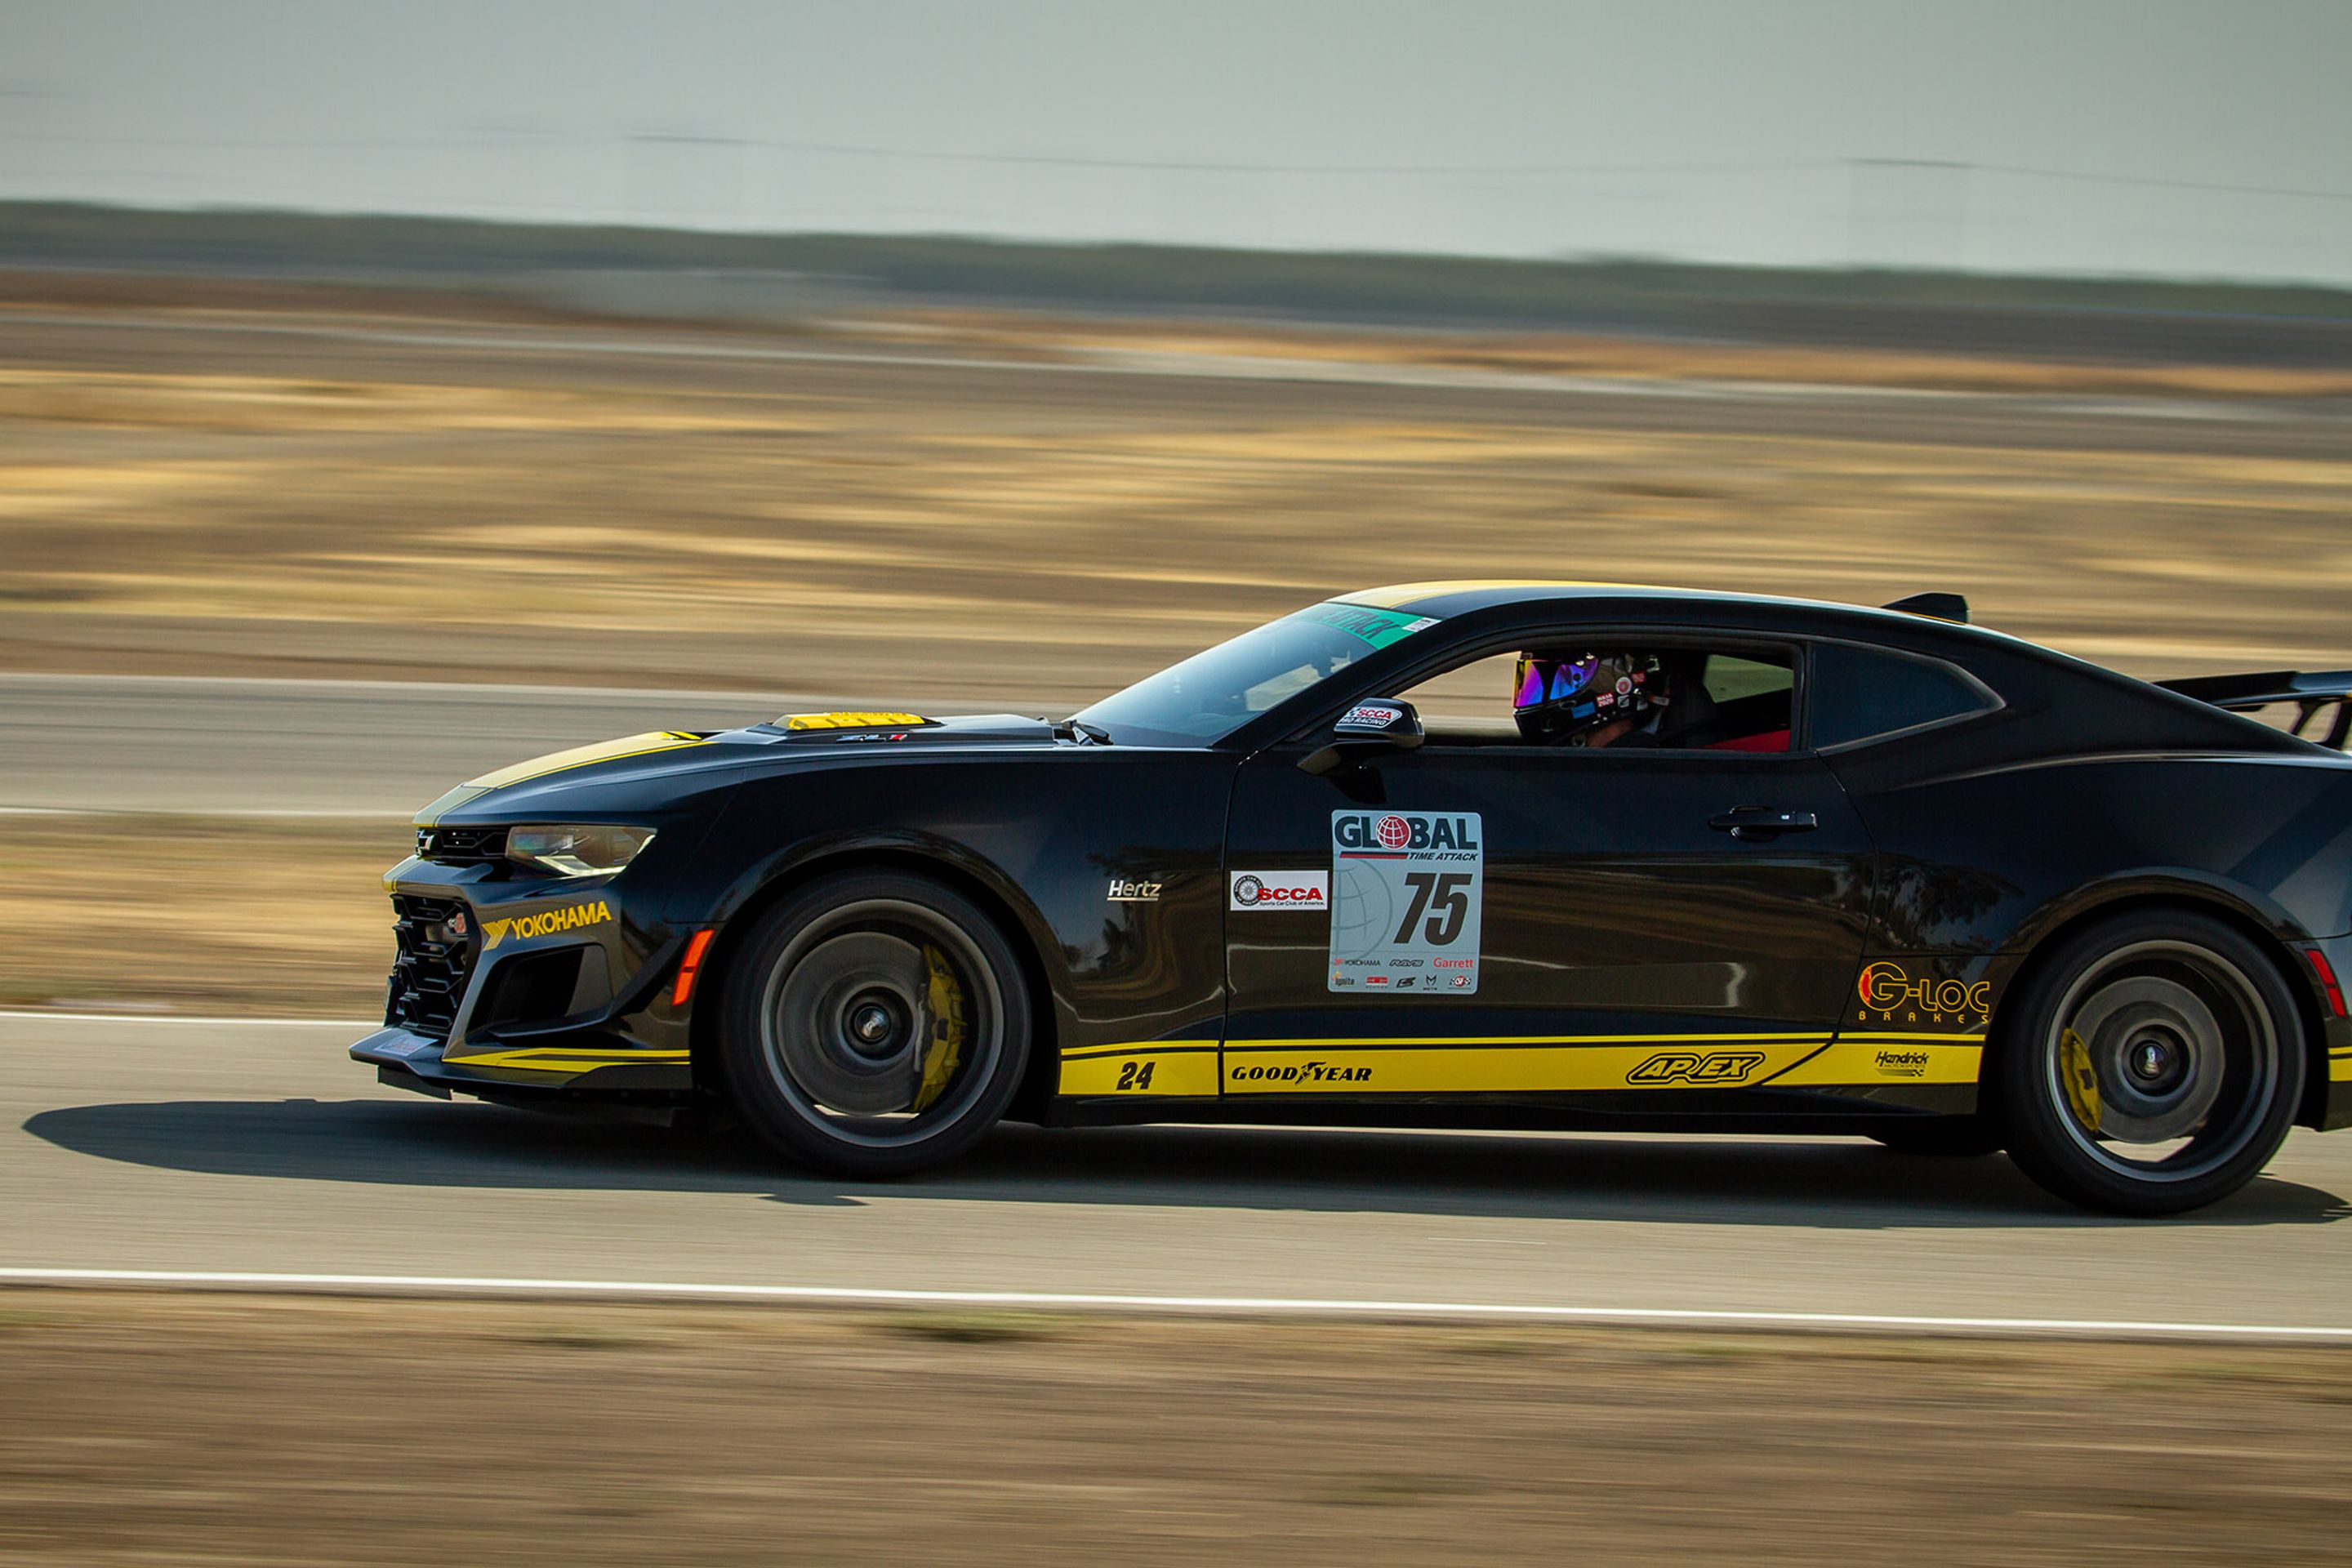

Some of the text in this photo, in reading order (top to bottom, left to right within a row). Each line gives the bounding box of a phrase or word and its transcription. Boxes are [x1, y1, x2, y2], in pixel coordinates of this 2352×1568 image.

[1357, 709, 1392, 719] SCCA
[1334, 815, 1477, 850] GLOBAL
[1108, 880, 1163, 897] Hertz
[1258, 888, 1323, 901] SCCA
[1393, 873, 1473, 946] 75
[511, 901, 612, 940] YOKOHAMA
[1432, 957, 1474, 969] Garrett
[1858, 961, 1991, 1013] G-LOC
[1858, 1011, 1989, 1025] BRAKES
[1635, 1057, 1757, 1079] APEX
[1875, 1051, 1929, 1067] Hendrick
[1116, 1062, 1156, 1089] 24
